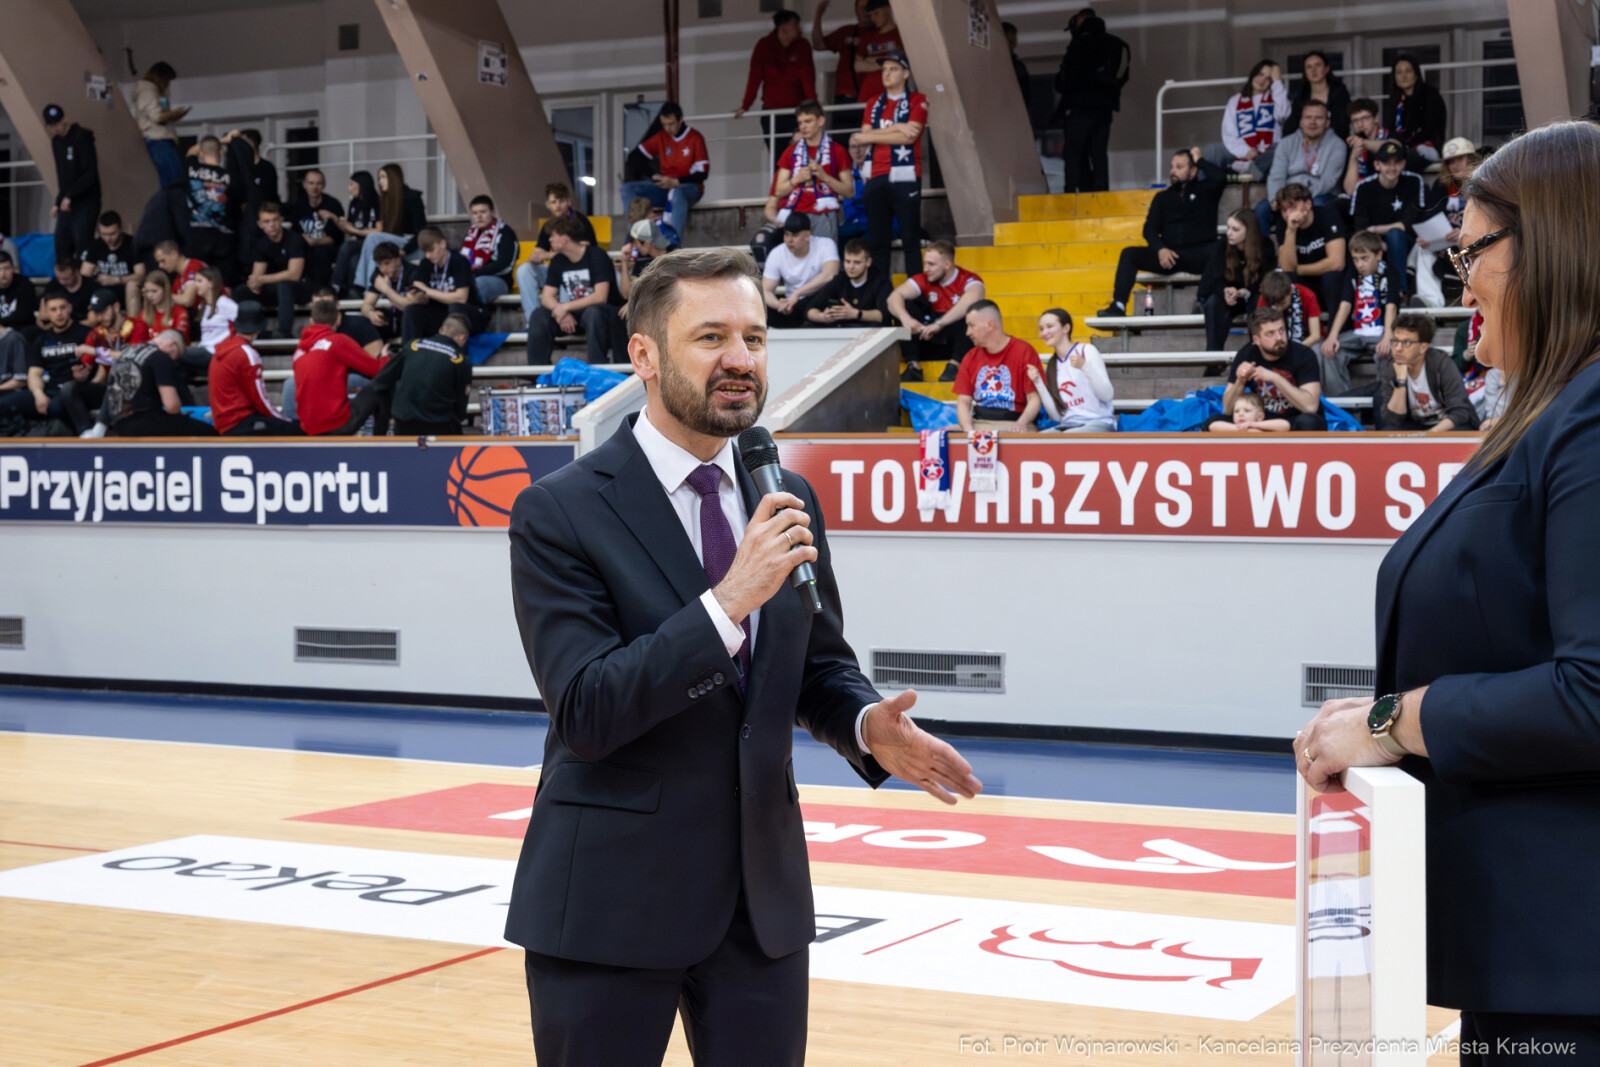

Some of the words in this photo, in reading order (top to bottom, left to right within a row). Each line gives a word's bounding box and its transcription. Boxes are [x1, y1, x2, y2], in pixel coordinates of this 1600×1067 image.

[0, 456, 202, 523] Przyjaciel
[220, 456, 389, 526] Sportu
[831, 460, 1357, 531] TOWARZYSTWO
[102, 856, 497, 906] Pekao
